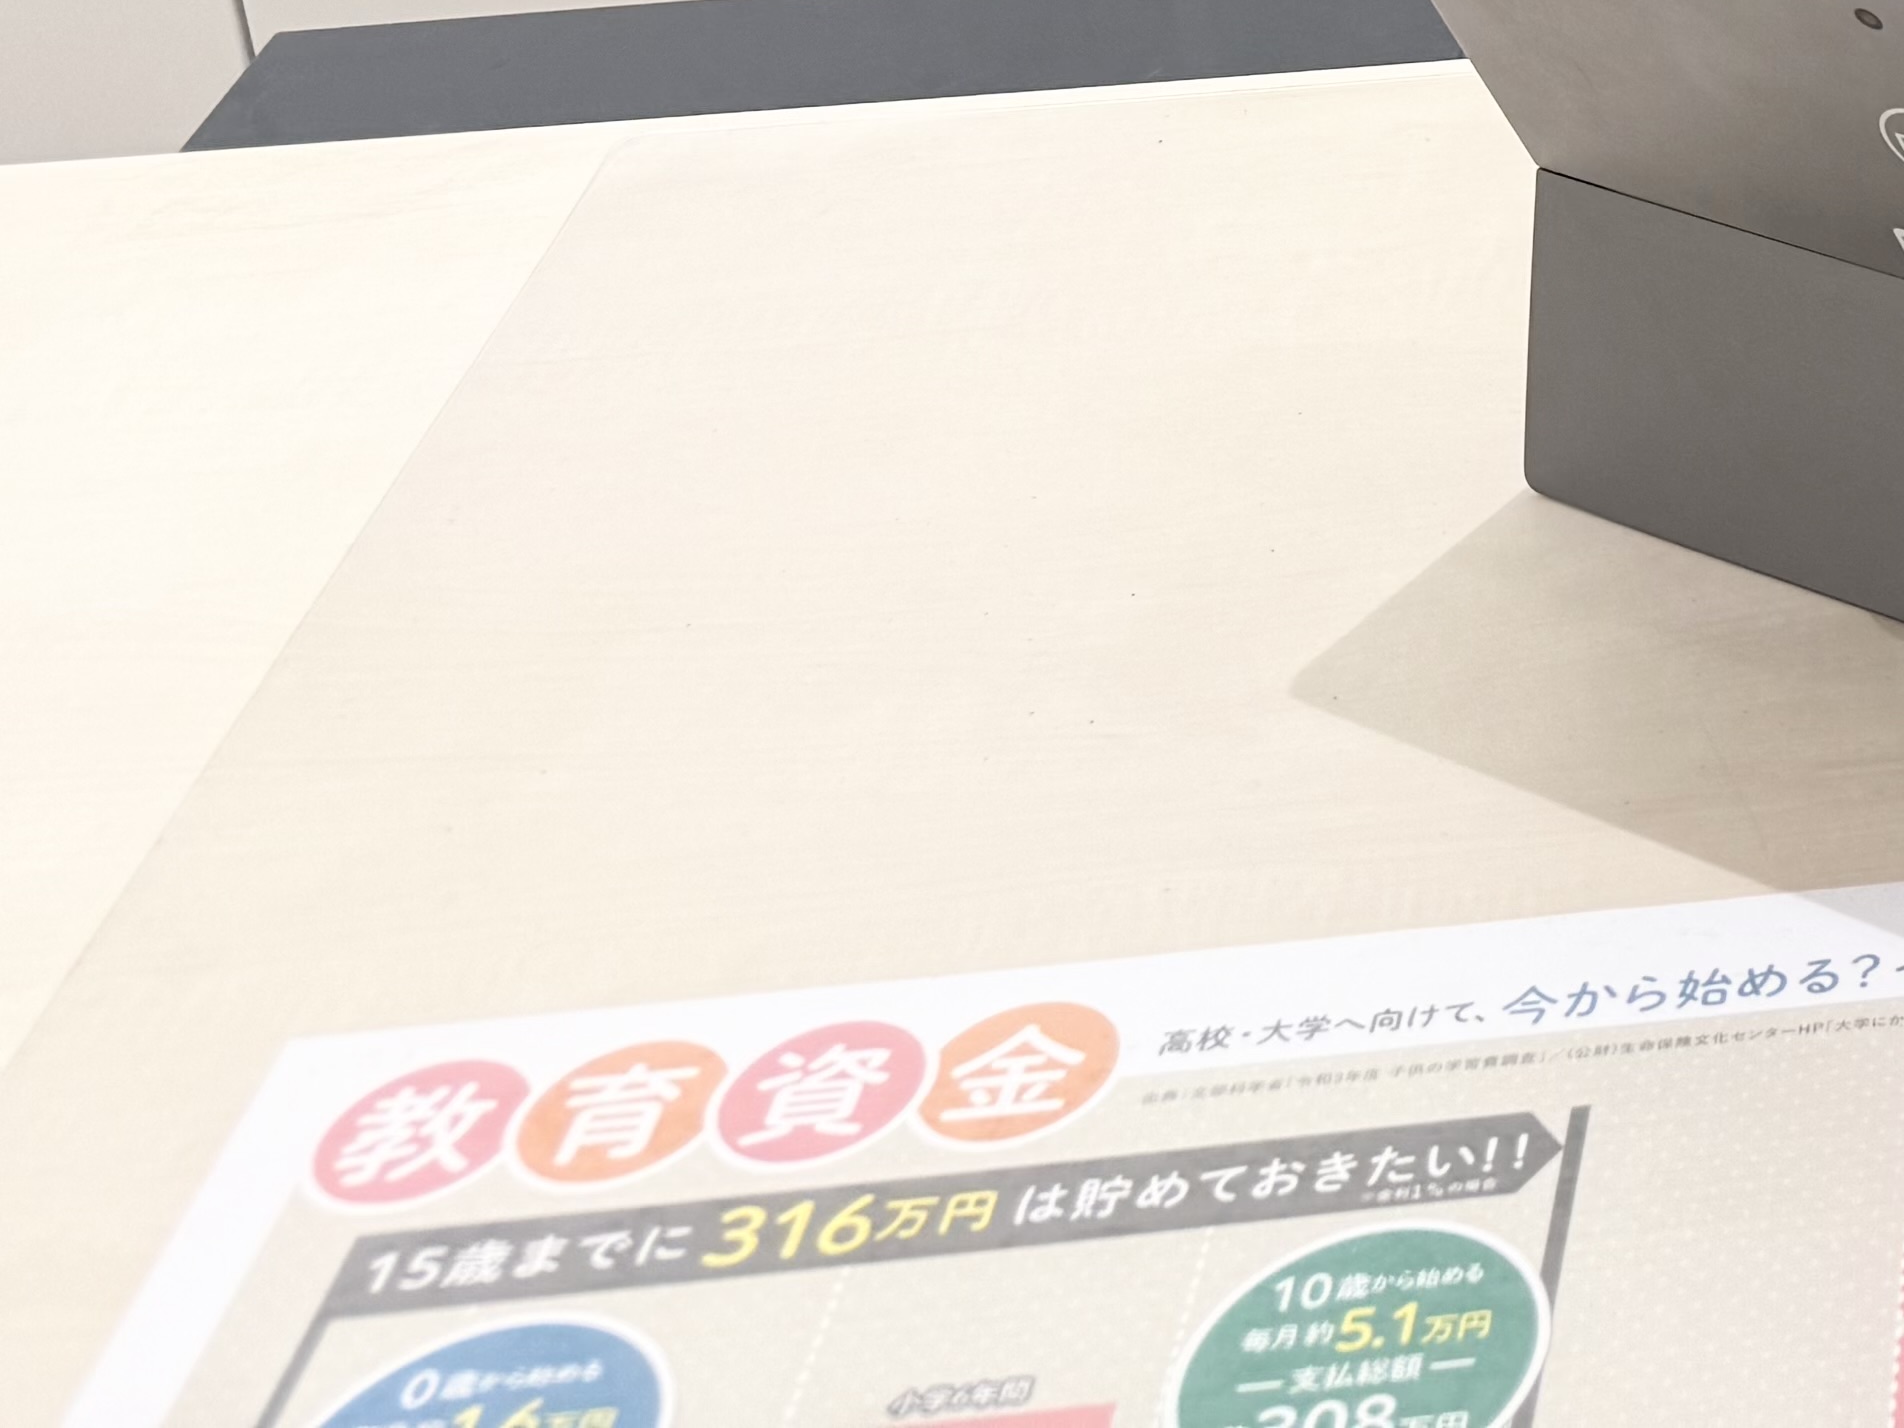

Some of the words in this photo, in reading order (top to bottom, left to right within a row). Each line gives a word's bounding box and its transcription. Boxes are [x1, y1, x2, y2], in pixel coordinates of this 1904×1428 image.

[330, 1020, 1082, 1187] 教育資金
[1273, 1262, 1485, 1313] 10歳から始める
[1240, 1301, 1495, 1354] 毎月約5.1万円
[1286, 1353, 1425, 1395] 支払総額
